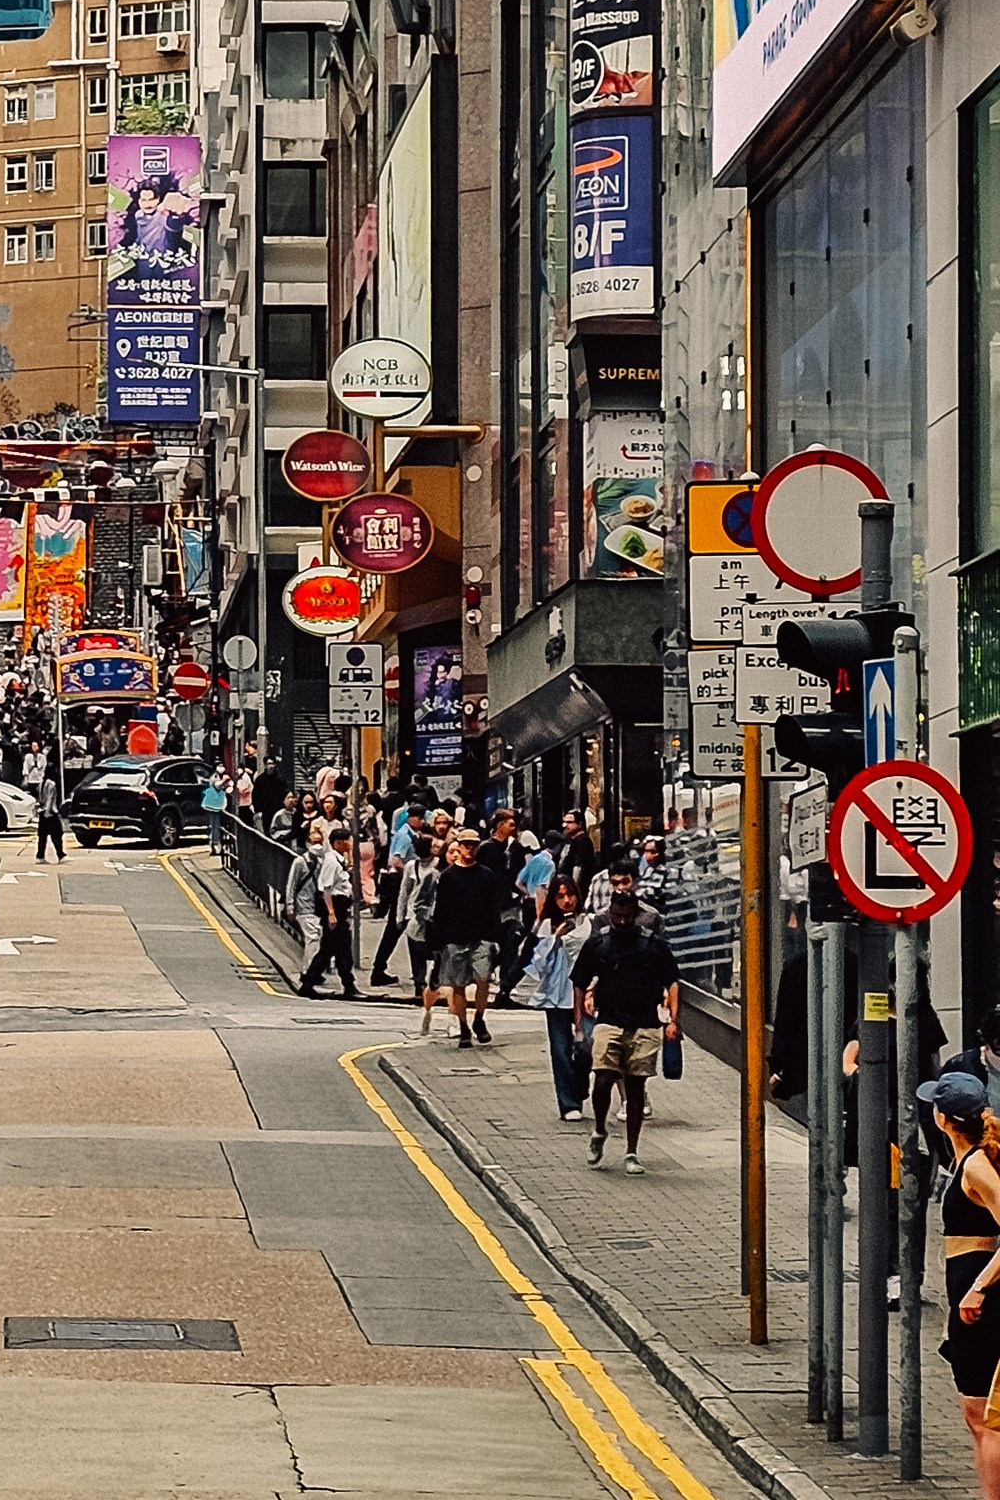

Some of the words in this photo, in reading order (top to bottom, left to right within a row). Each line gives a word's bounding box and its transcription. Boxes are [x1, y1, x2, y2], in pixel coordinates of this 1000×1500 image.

[573, 219, 627, 260] 8/F
[604, 278, 641, 291] 4027
[363, 358, 399, 371] NCB
[127, 367, 160, 379] 3628
[161, 367, 194, 379] 4027
[290, 460, 337, 472] Watson's
[720, 560, 742, 570] am
[713, 574, 750, 590] 上午
[720, 607, 743, 619] pm
[749, 609, 790, 620] Length
[791, 609, 818, 619] over
[703, 668, 729, 682] pick
[363, 689, 373, 702] 7
[364, 709, 381, 723] 12
[698, 743, 744, 755] midnig
